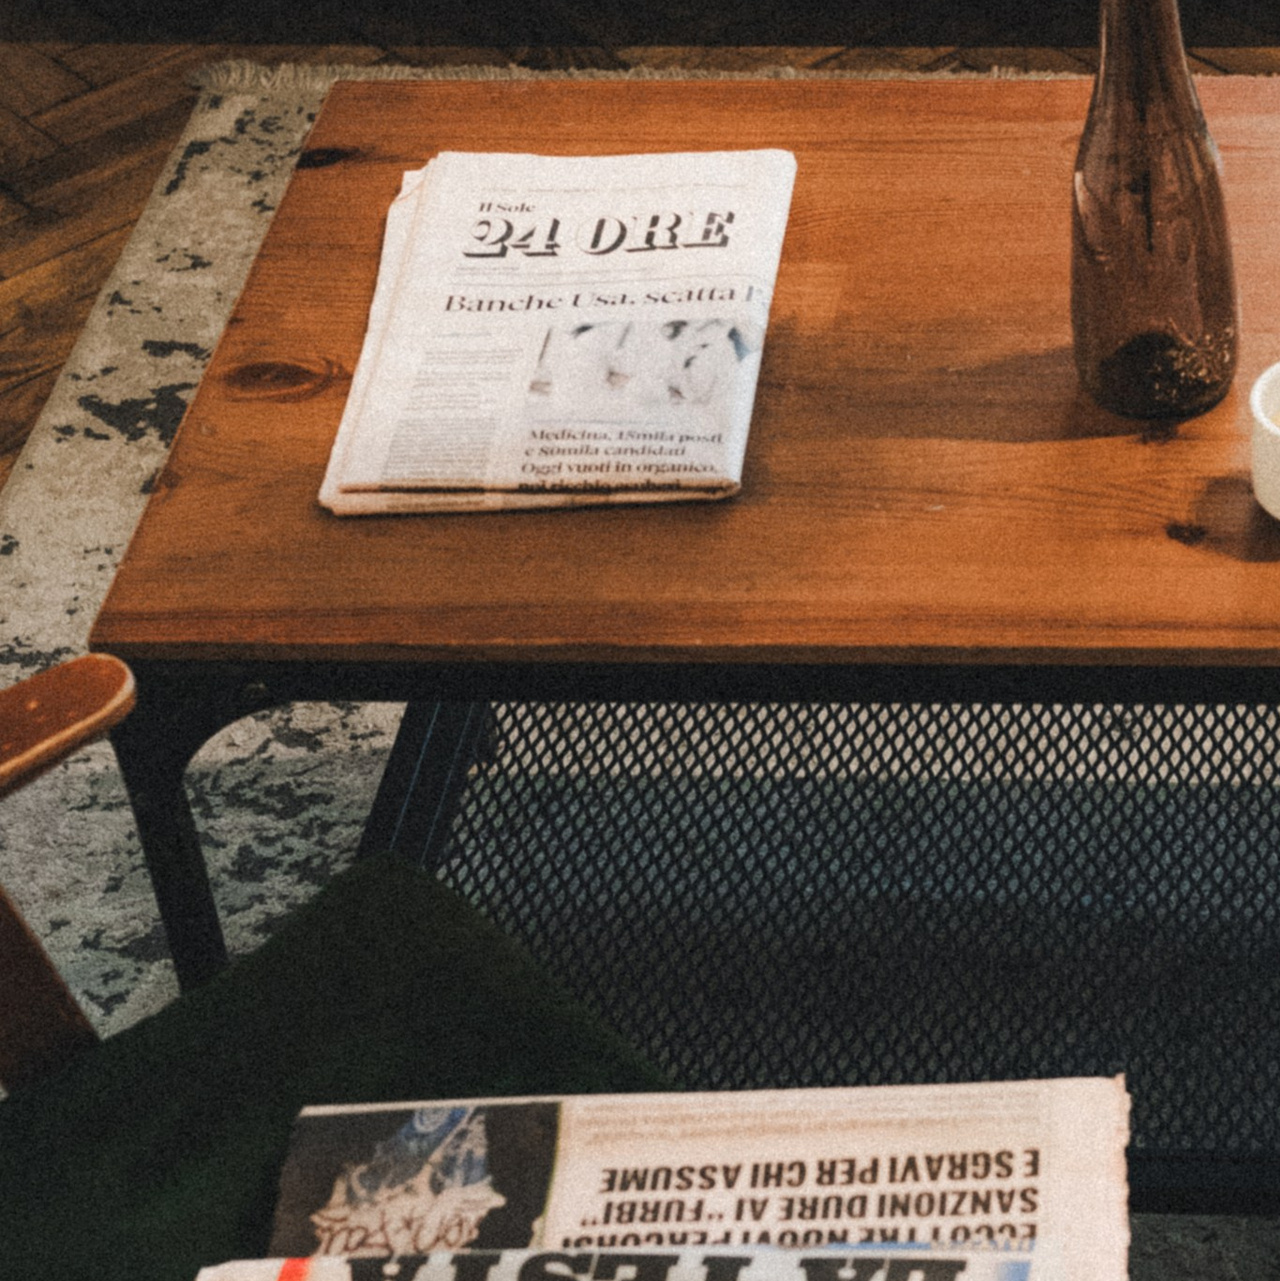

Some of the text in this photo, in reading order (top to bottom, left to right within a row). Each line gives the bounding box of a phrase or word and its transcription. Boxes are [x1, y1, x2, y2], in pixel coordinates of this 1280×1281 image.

[496, 202, 536, 213] Sole
[461, 217, 562, 258] 24
[444, 293, 565, 313] Banche
[643, 286, 736, 305] scatta
[604, 445, 687, 457] candidati
[677, 432, 724, 445] posti
[521, 461, 563, 476] Oggi
[567, 461, 612, 474] vuoti
[615, 460, 634, 474] in
[599, 1148, 1041, 1194] E SGRAVI PER CHI ASSUME
[735, 1197, 769, 1222] AI
[779, 1194, 868, 1222] DURE
[878, 1187, 1039, 1219] SANZIONI
